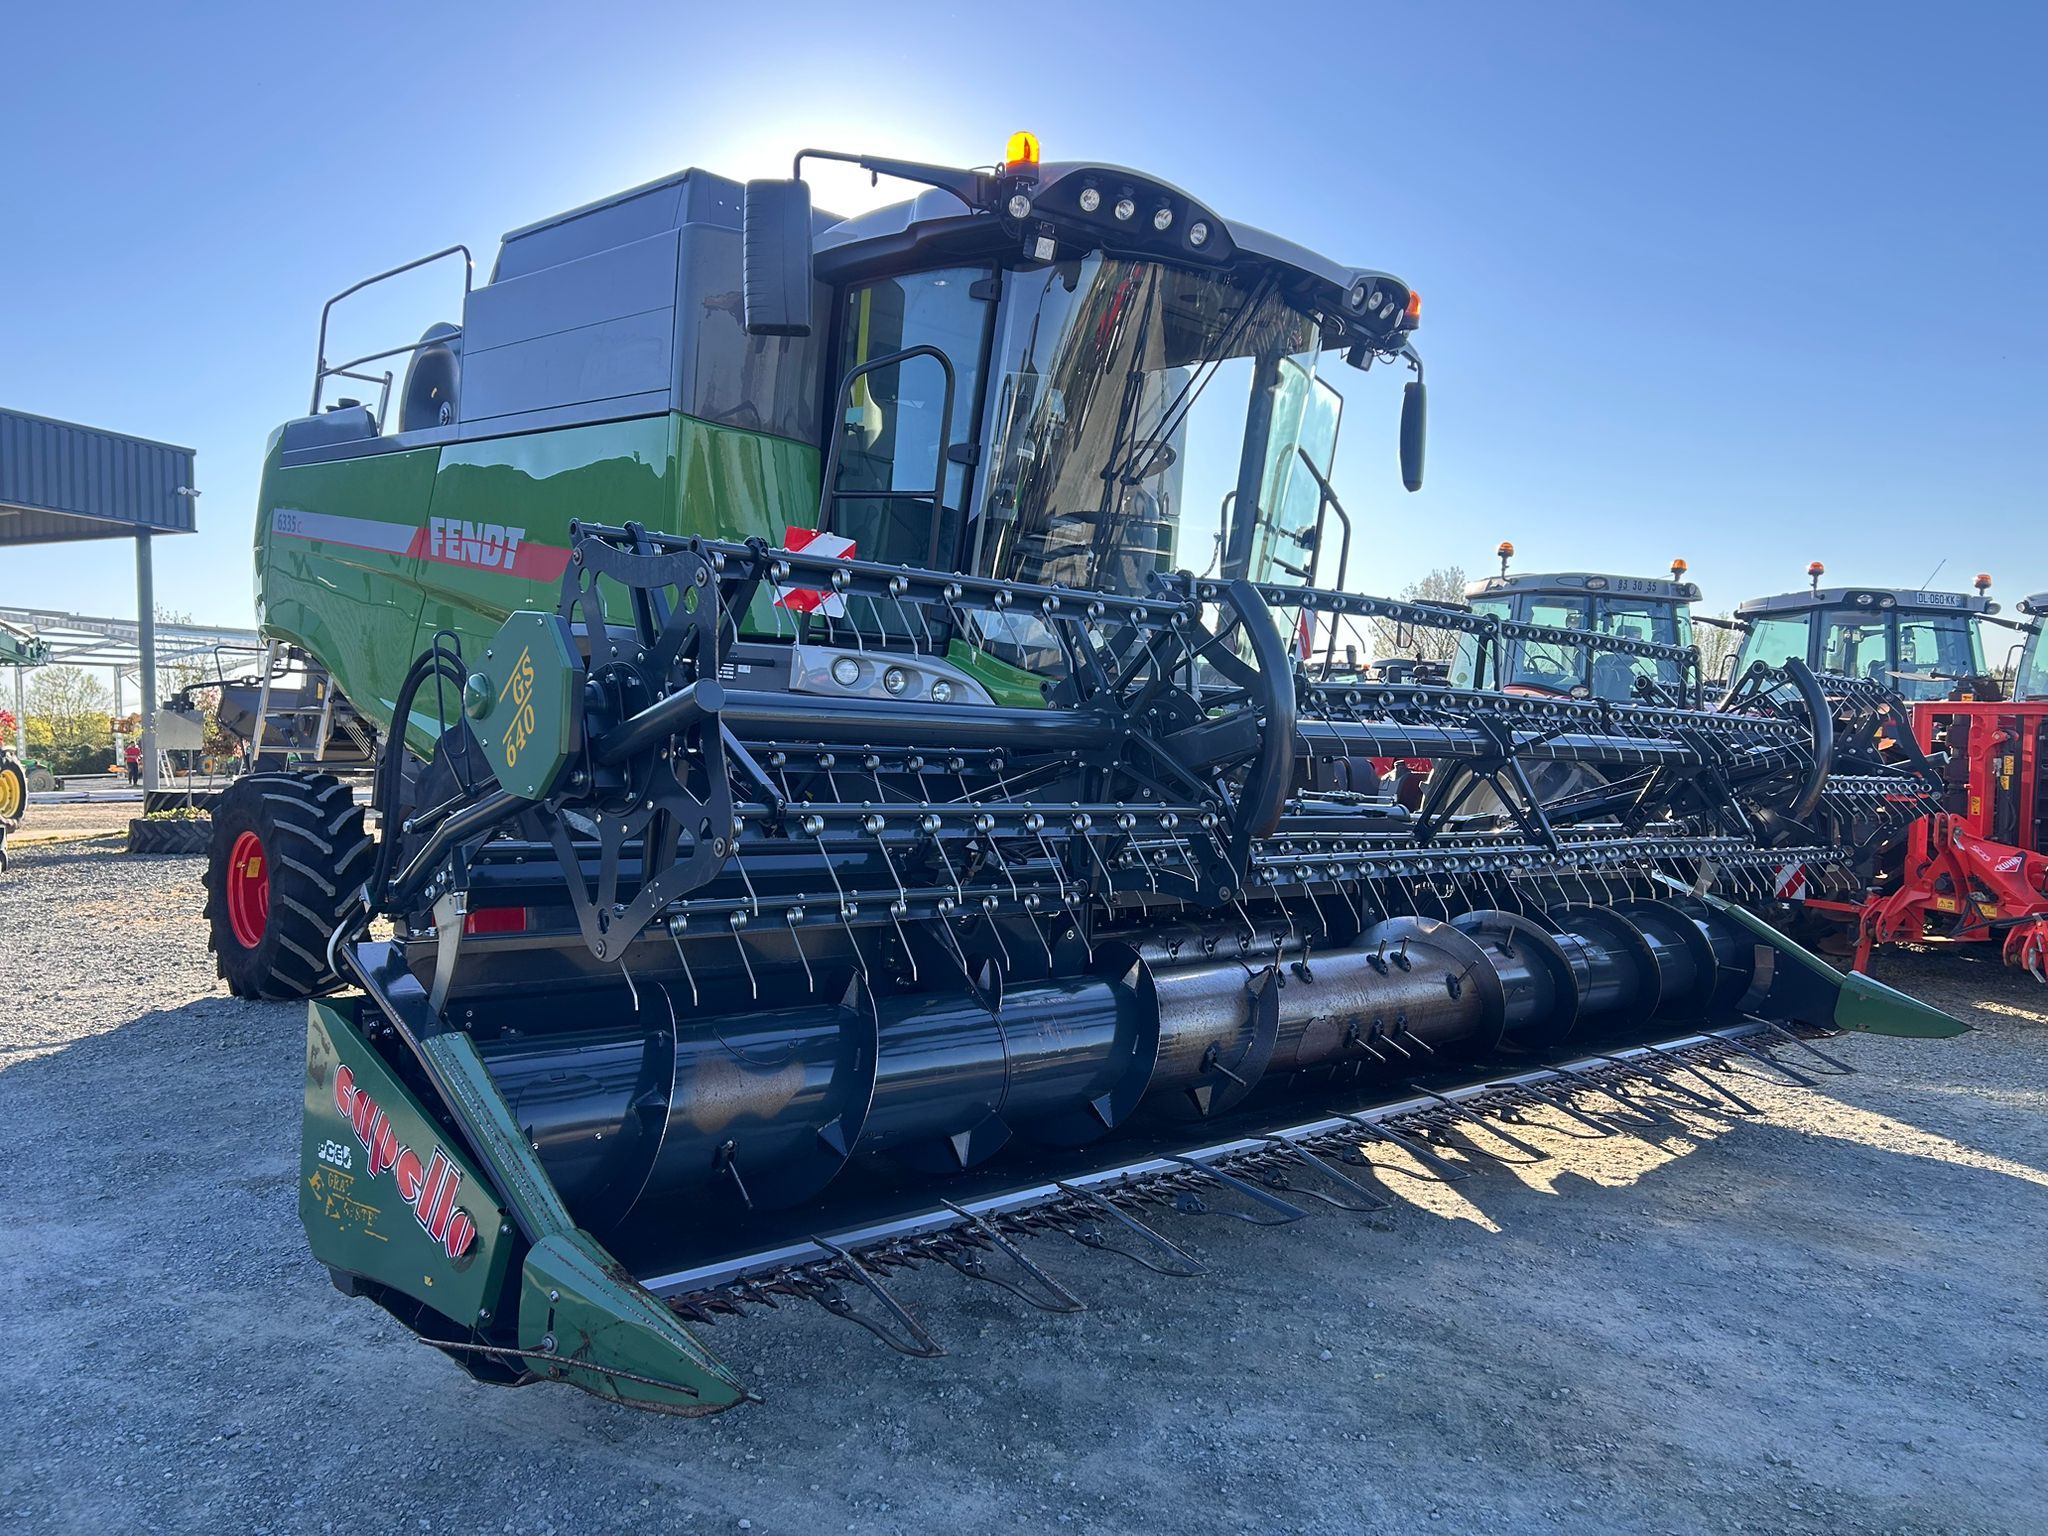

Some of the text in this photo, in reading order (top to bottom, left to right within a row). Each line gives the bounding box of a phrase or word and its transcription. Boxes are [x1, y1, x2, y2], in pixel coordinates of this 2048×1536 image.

[430, 516, 526, 570] FENDT
[512, 654, 535, 705] GS
[506, 704, 535, 768] 640
